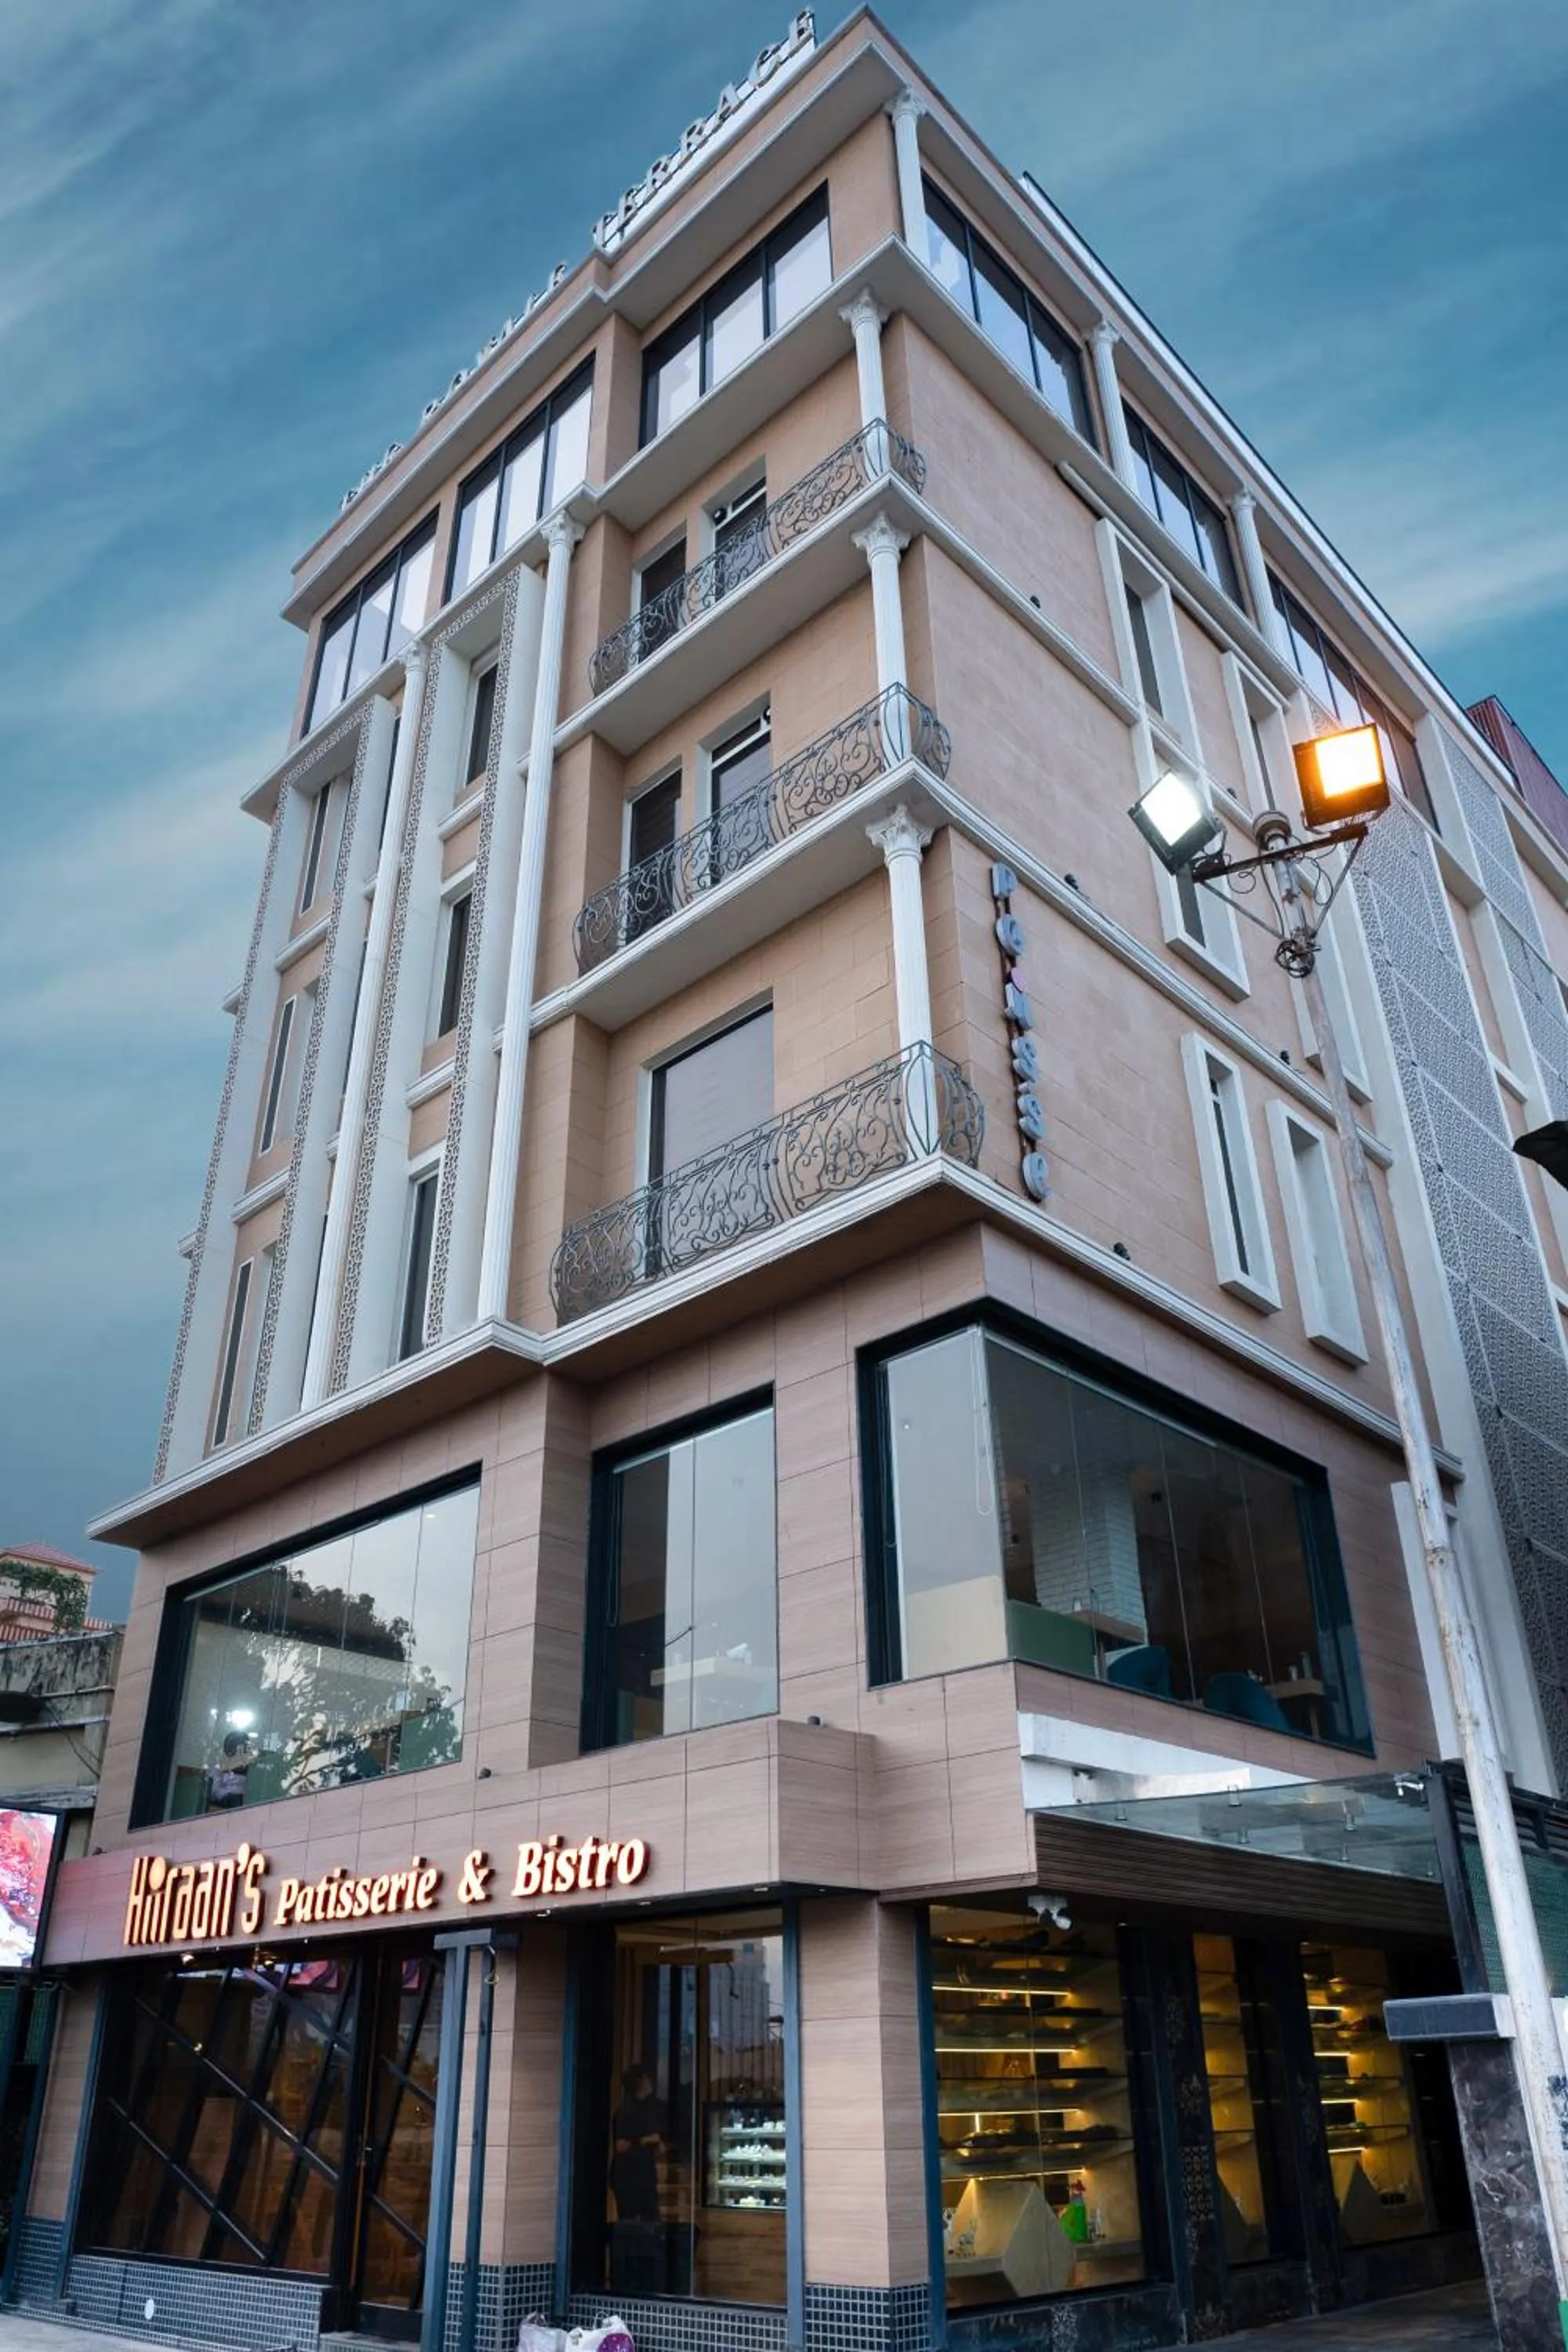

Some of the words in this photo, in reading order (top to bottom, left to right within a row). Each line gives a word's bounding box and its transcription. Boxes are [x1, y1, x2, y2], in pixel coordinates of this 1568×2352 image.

[591, 7, 817, 249] TERRACE
[274, 1856, 442, 1926] Patisserie
[457, 1849, 495, 1905] &
[511, 1834, 651, 1897] Bistro
